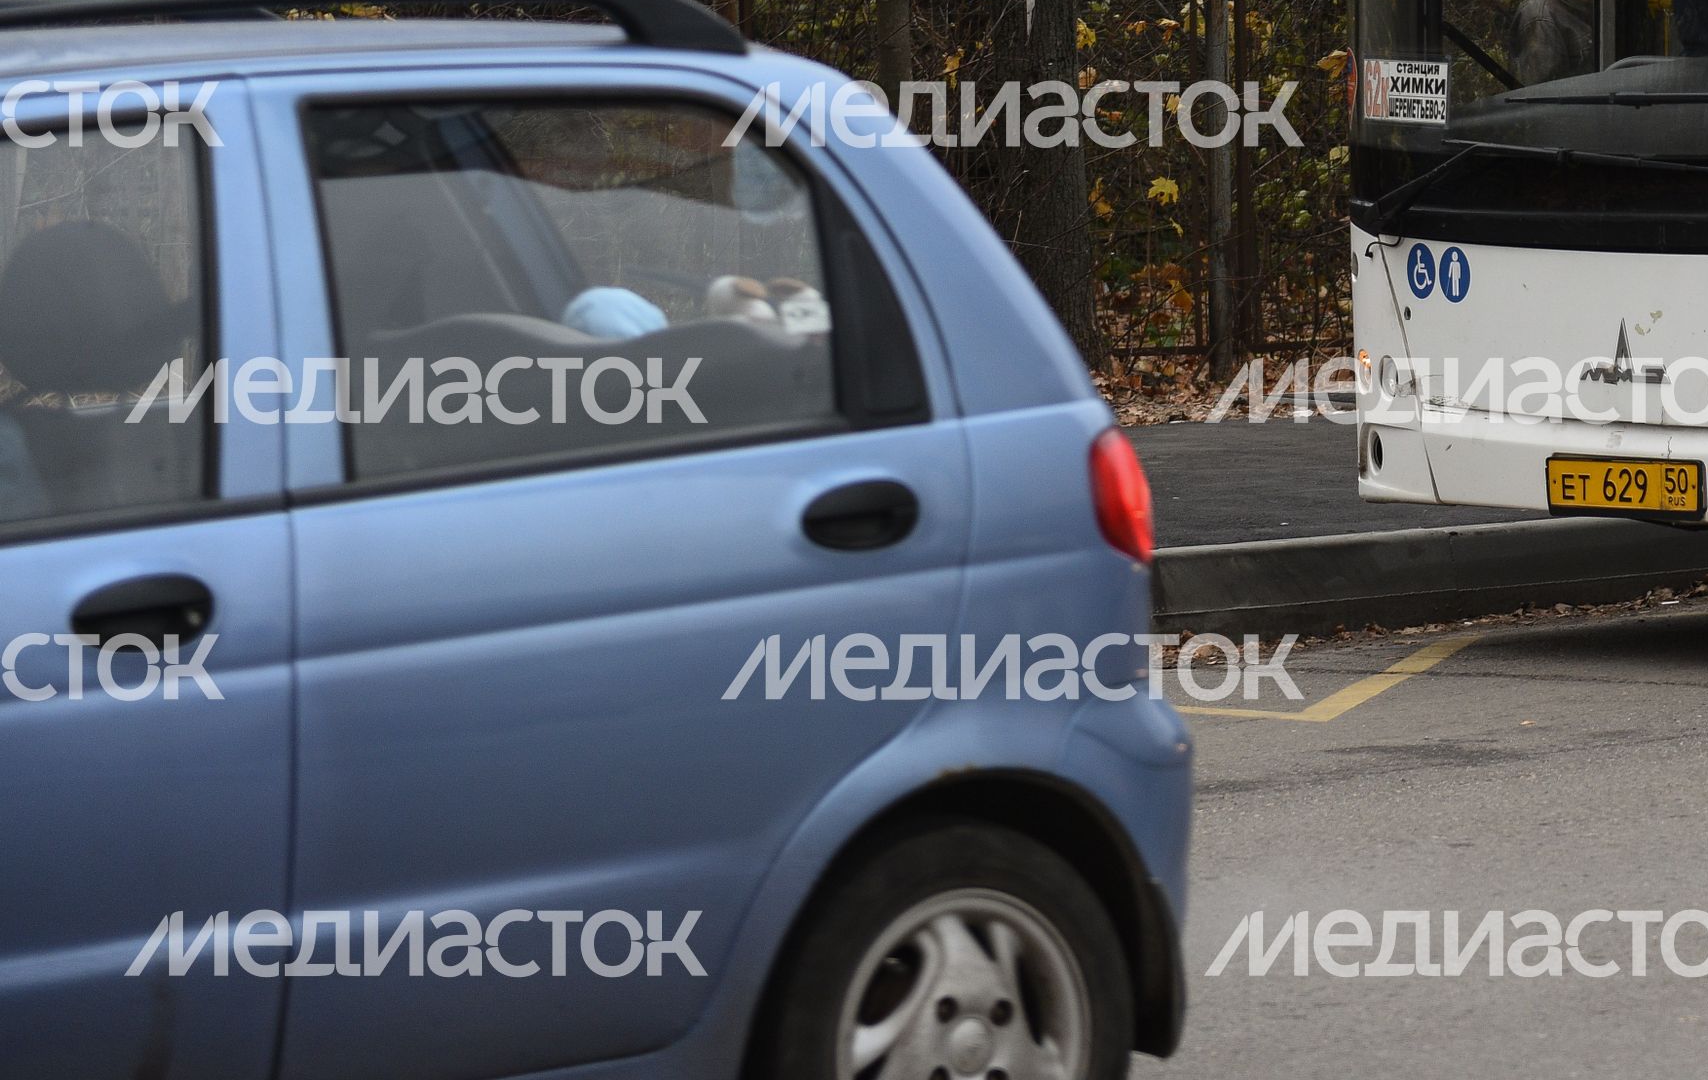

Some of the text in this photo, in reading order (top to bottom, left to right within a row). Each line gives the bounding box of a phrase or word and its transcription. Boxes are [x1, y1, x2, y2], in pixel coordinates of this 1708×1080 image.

[1396, 62, 1440, 76] станция
[1390, 76, 1446, 95] ХИМКИ
[1389, 98, 1446, 120] ШЕРЕМЕТЬЕВО-2
[1602, 467, 1648, 503] 629
[1664, 467, 1689, 495] 50
[1668, 496, 1686, 507] RUS
